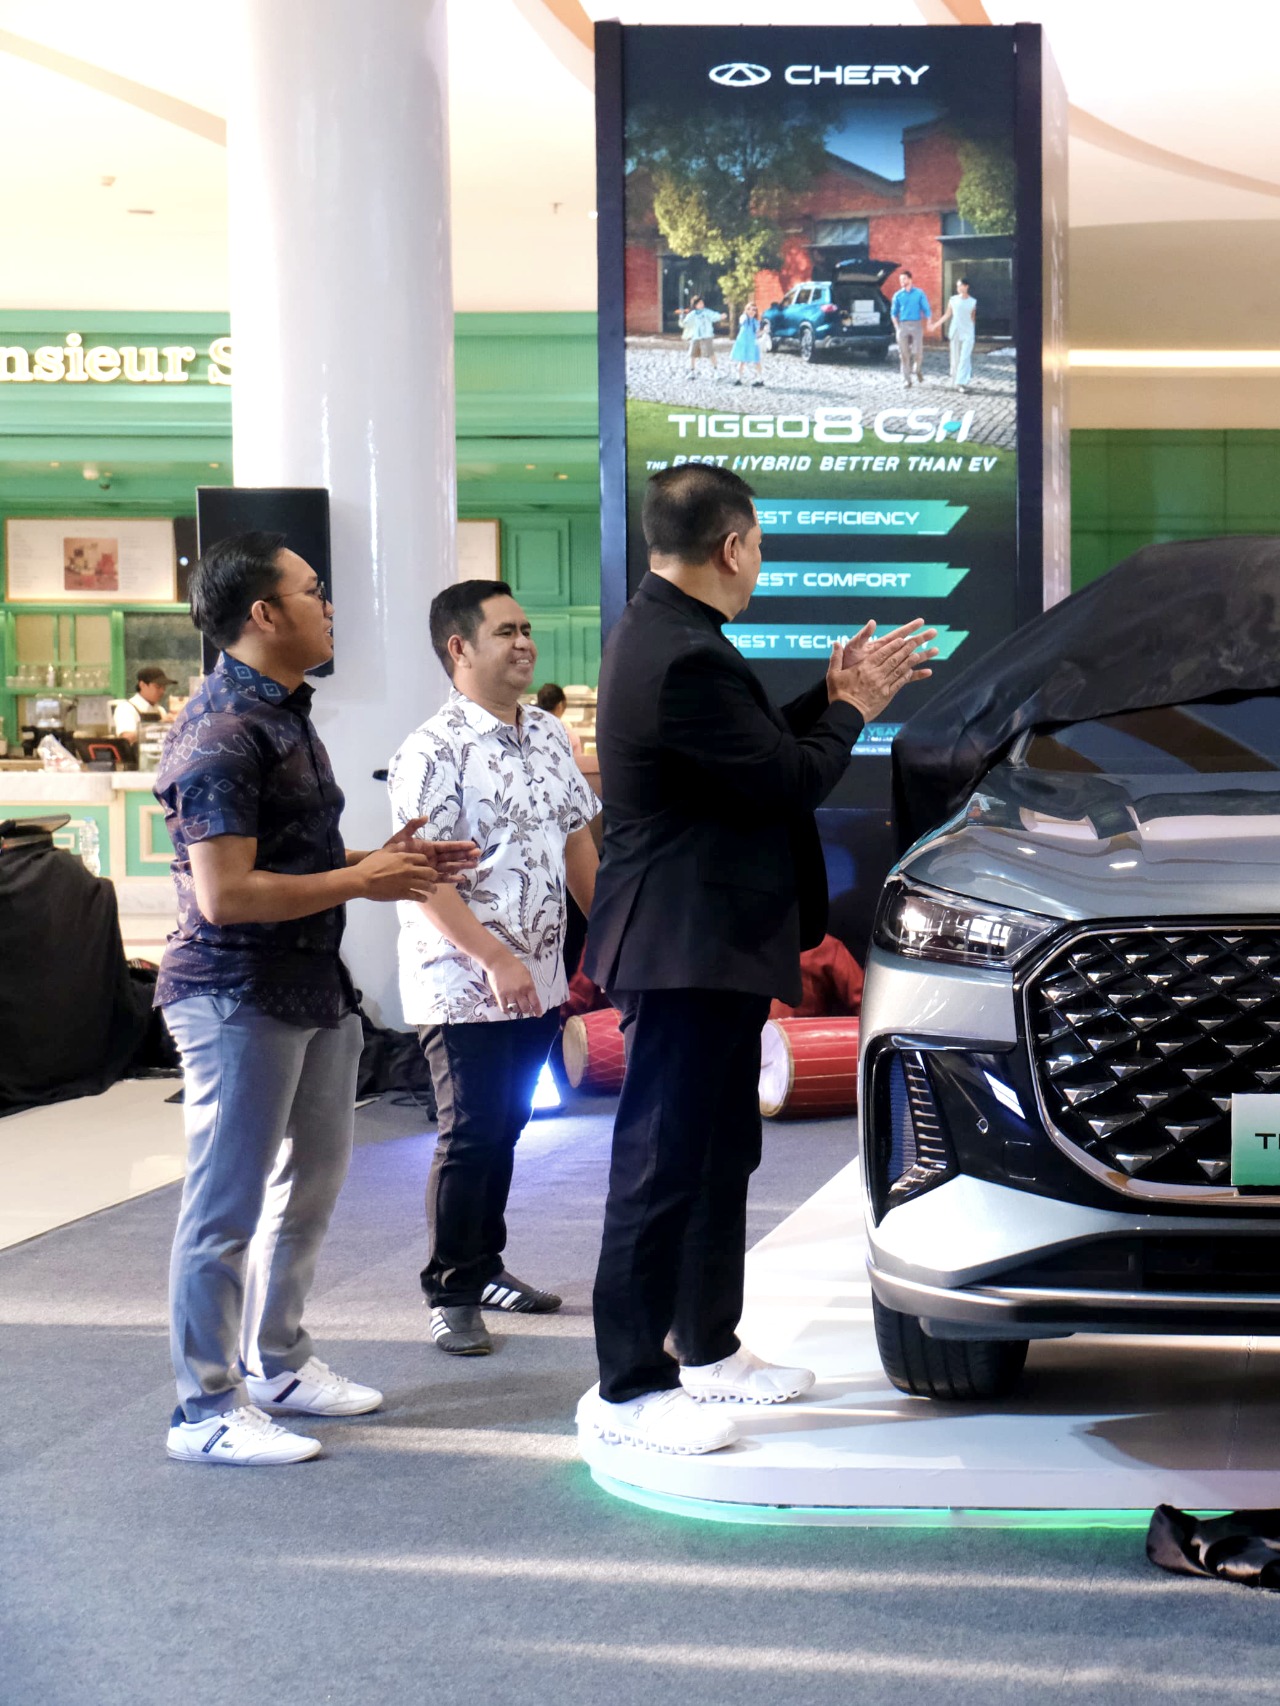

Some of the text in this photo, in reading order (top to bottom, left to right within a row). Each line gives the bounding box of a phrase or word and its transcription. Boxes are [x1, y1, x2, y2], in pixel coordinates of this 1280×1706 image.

[784, 65, 930, 85] CHERY
[208, 337, 231, 384] S
[874, 408, 975, 443] CSH
[646, 461, 668, 470] THE
[732, 455, 811, 471] HYBRID
[820, 455, 901, 471] BETTER
[908, 456, 961, 472] THAN
[968, 456, 997, 472] EV
[756, 511, 920, 525] EST EFFICIENCY
[757, 573, 911, 587] EST COMFORT
